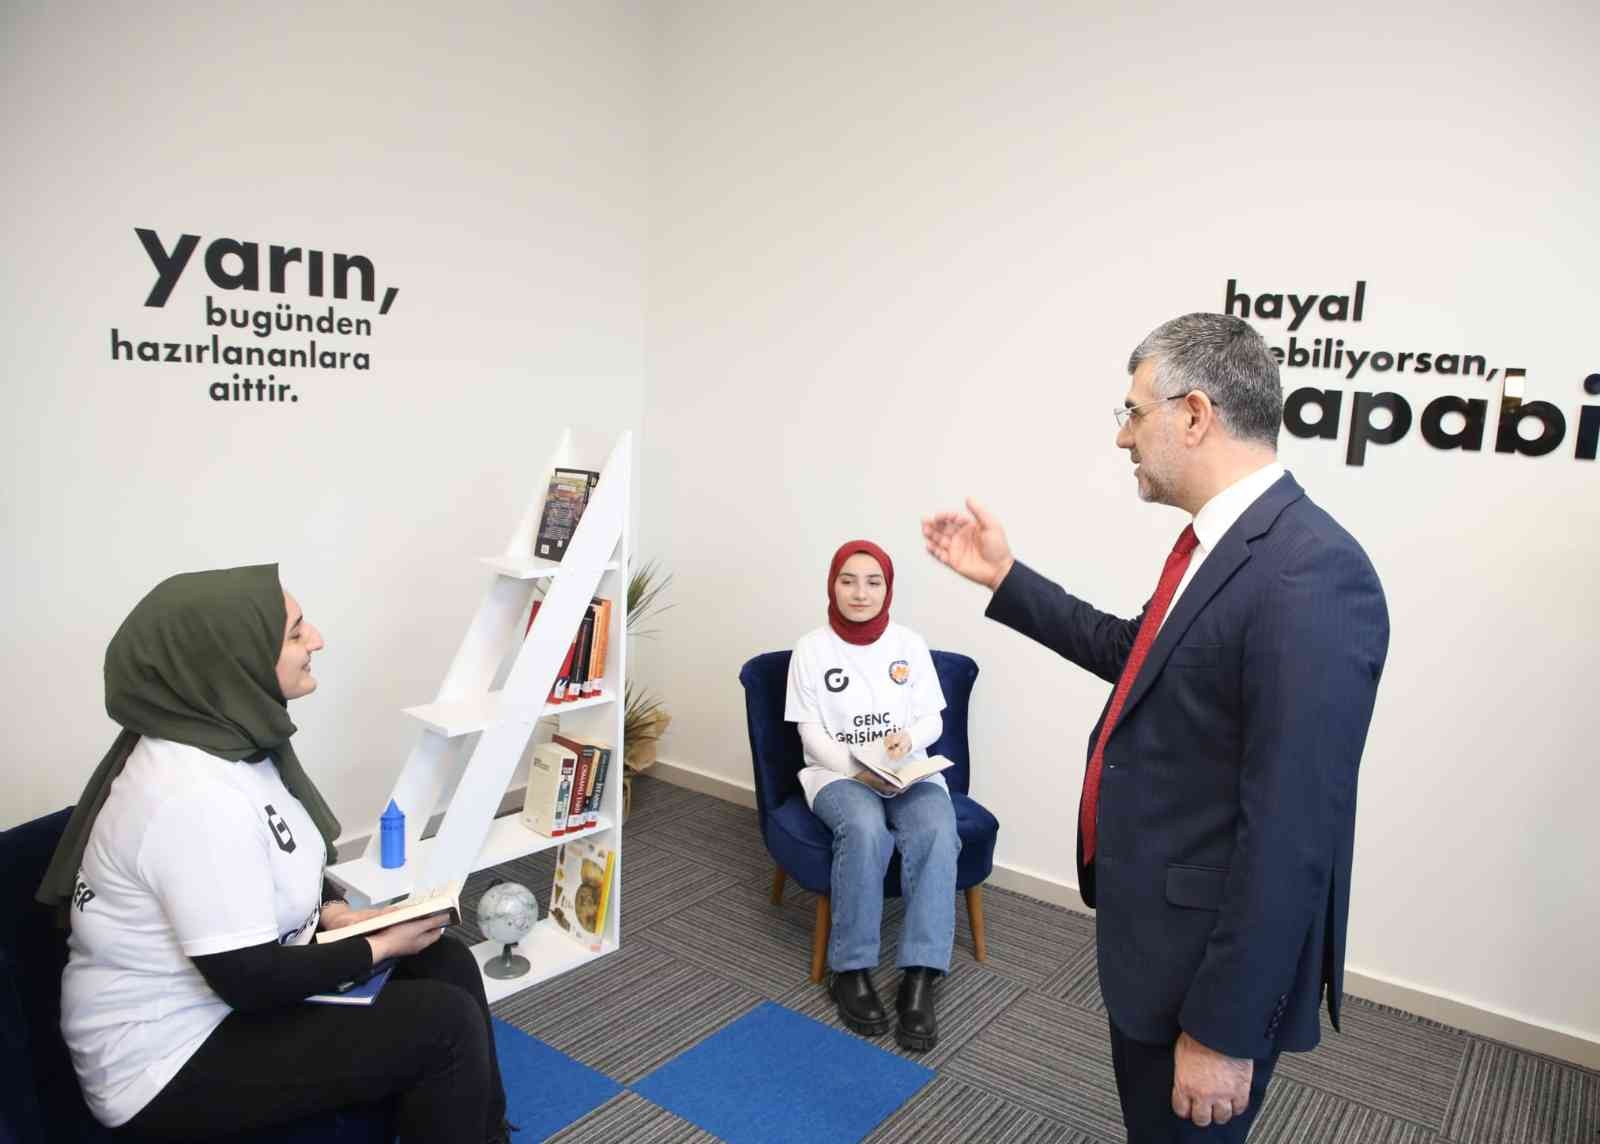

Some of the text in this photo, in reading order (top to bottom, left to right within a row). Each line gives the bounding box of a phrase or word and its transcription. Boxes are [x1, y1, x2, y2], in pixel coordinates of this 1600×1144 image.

[134, 227, 399, 315] yarın,
[206, 296, 371, 338] bugünden
[1224, 279, 1366, 331] hayal
[111, 328, 370, 370] hazırlananlara
[1266, 336, 1499, 381] ebiliyorsan,
[209, 373, 298, 402] aittir.
[1280, 367, 1600, 467] apabi
[853, 711, 890, 728] GENÇ
